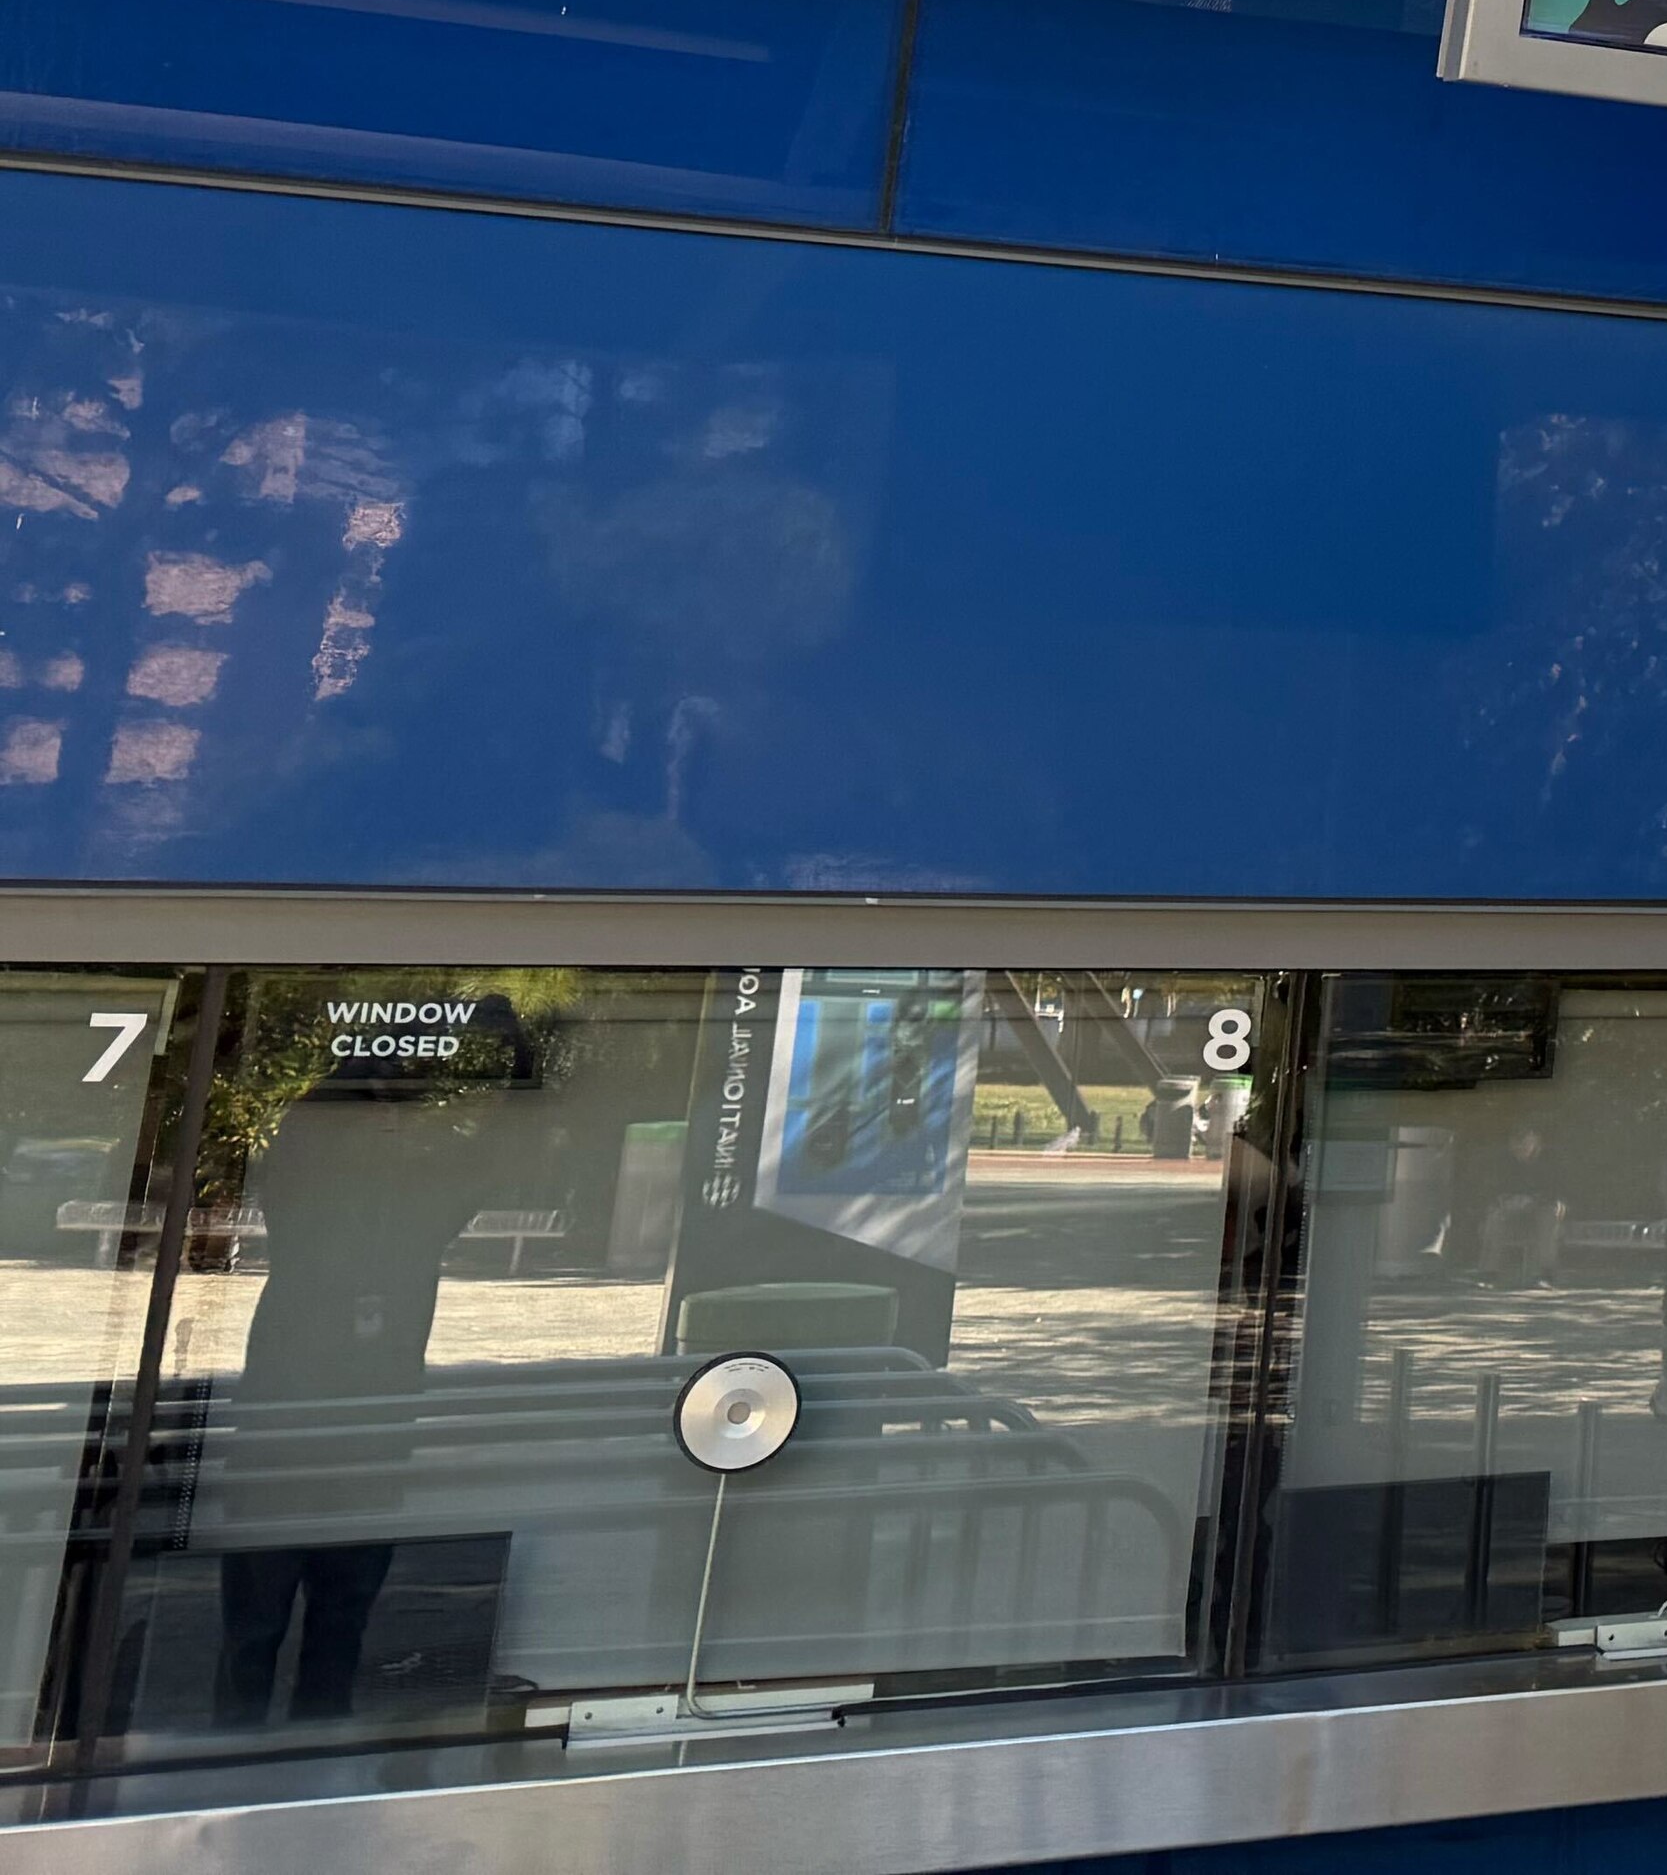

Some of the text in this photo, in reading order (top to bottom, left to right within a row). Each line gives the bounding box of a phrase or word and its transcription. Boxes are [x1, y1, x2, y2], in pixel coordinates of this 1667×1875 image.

[326, 1001, 477, 1024] WINDOW
[81, 1012, 148, 1083] 7
[330, 1034, 460, 1058] CLOSED
[1202, 1008, 1252, 1071] 8
